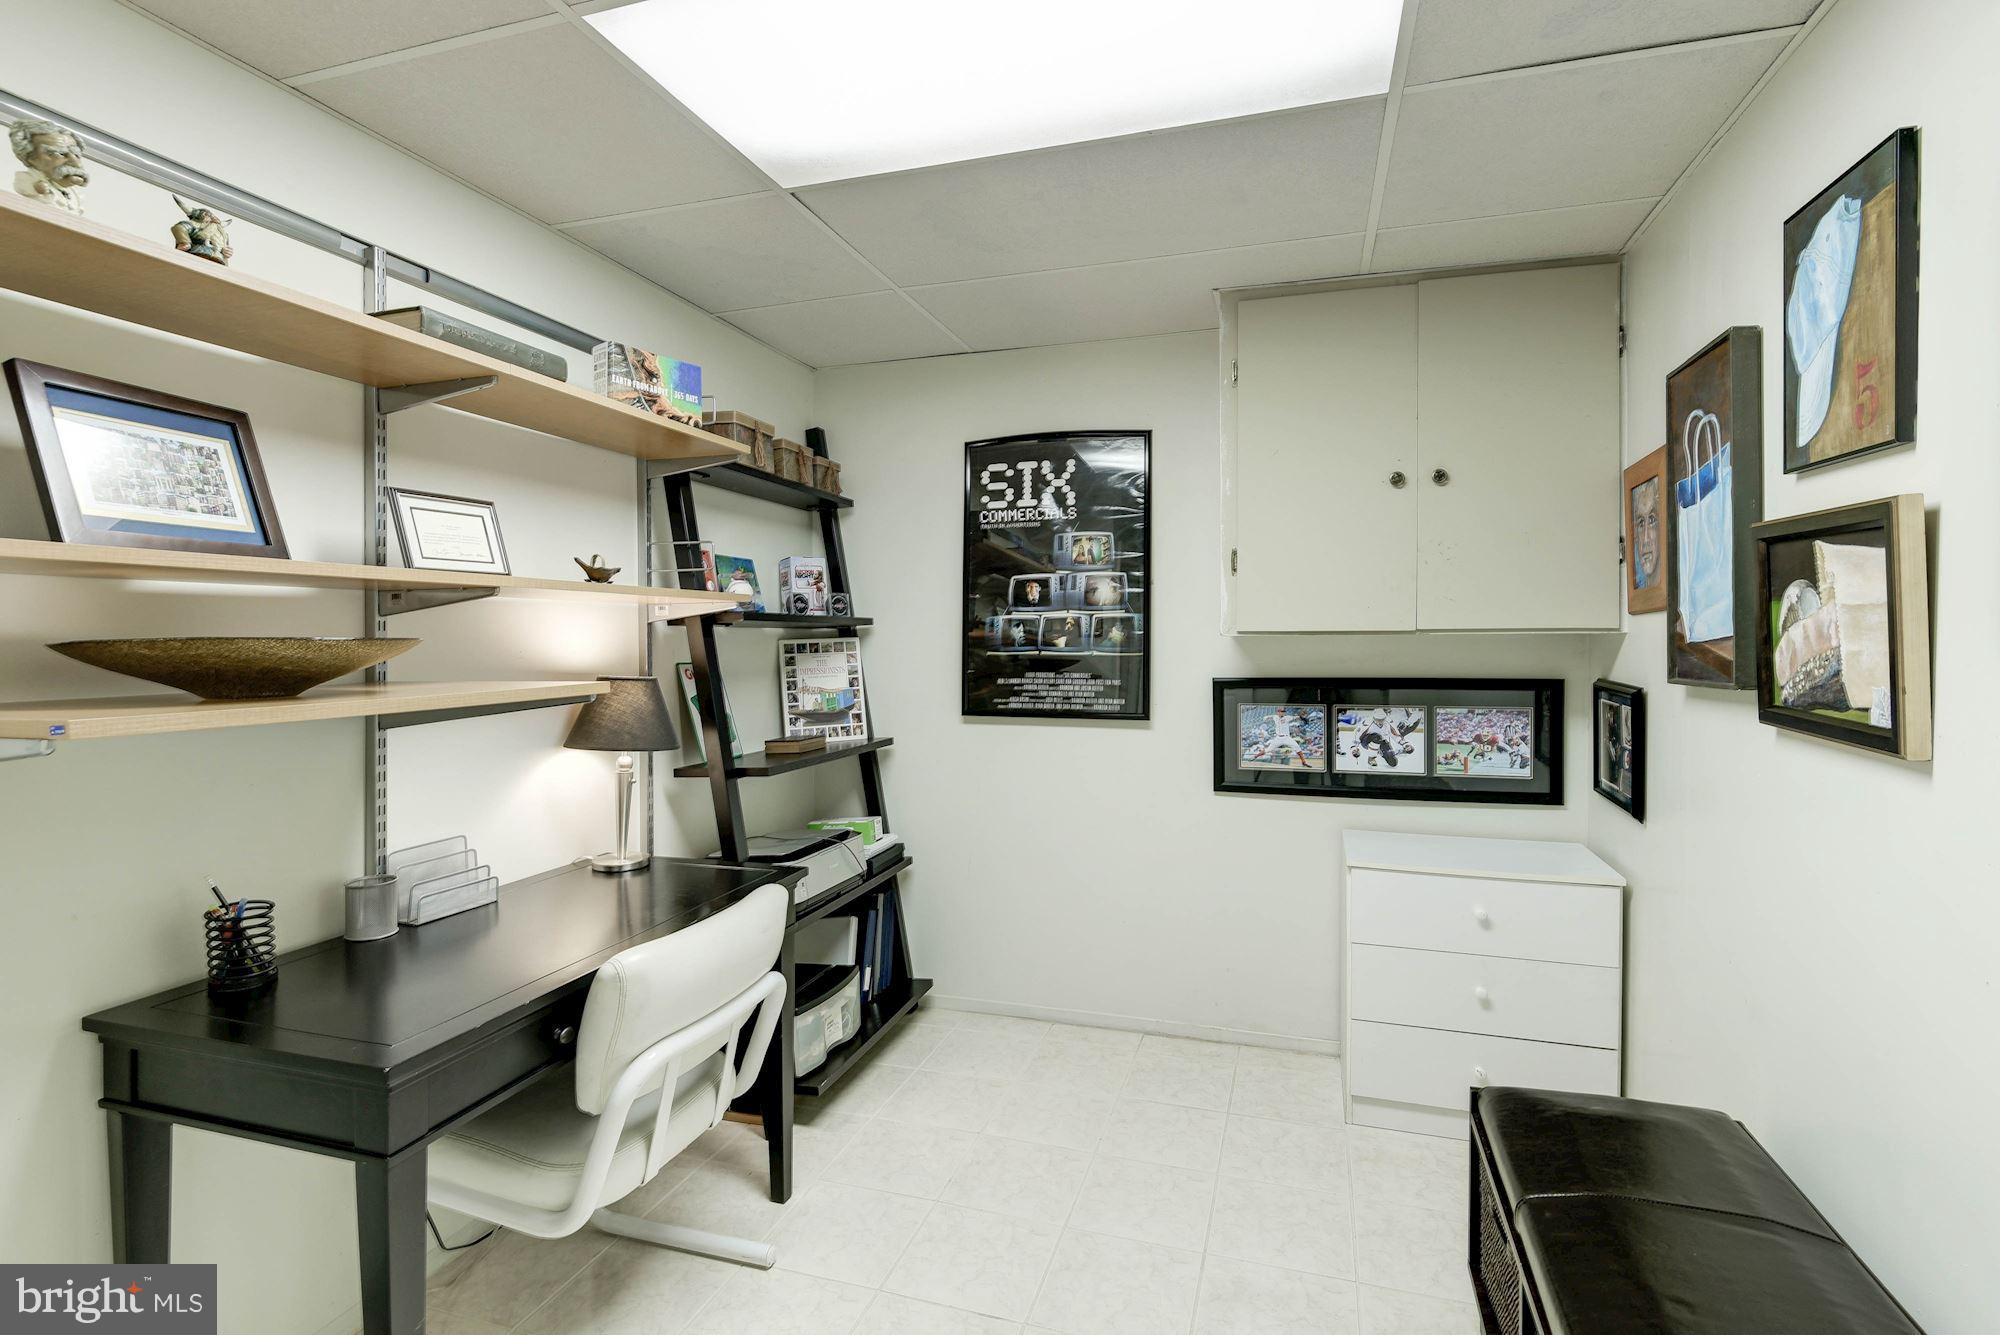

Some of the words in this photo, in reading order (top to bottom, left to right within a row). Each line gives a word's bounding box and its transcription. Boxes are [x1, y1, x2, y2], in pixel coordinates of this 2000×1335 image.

[611, 374, 632, 387] EARTH
[632, 380, 649, 391] FROM
[649, 384, 668, 396] ABOVE
[1856, 356, 1879, 431] 5
[673, 390, 684, 400] 365
[685, 393, 699, 404] DAYS
[980, 458, 1076, 510] SIX
[979, 507, 1077, 523] COMMERCIALS
